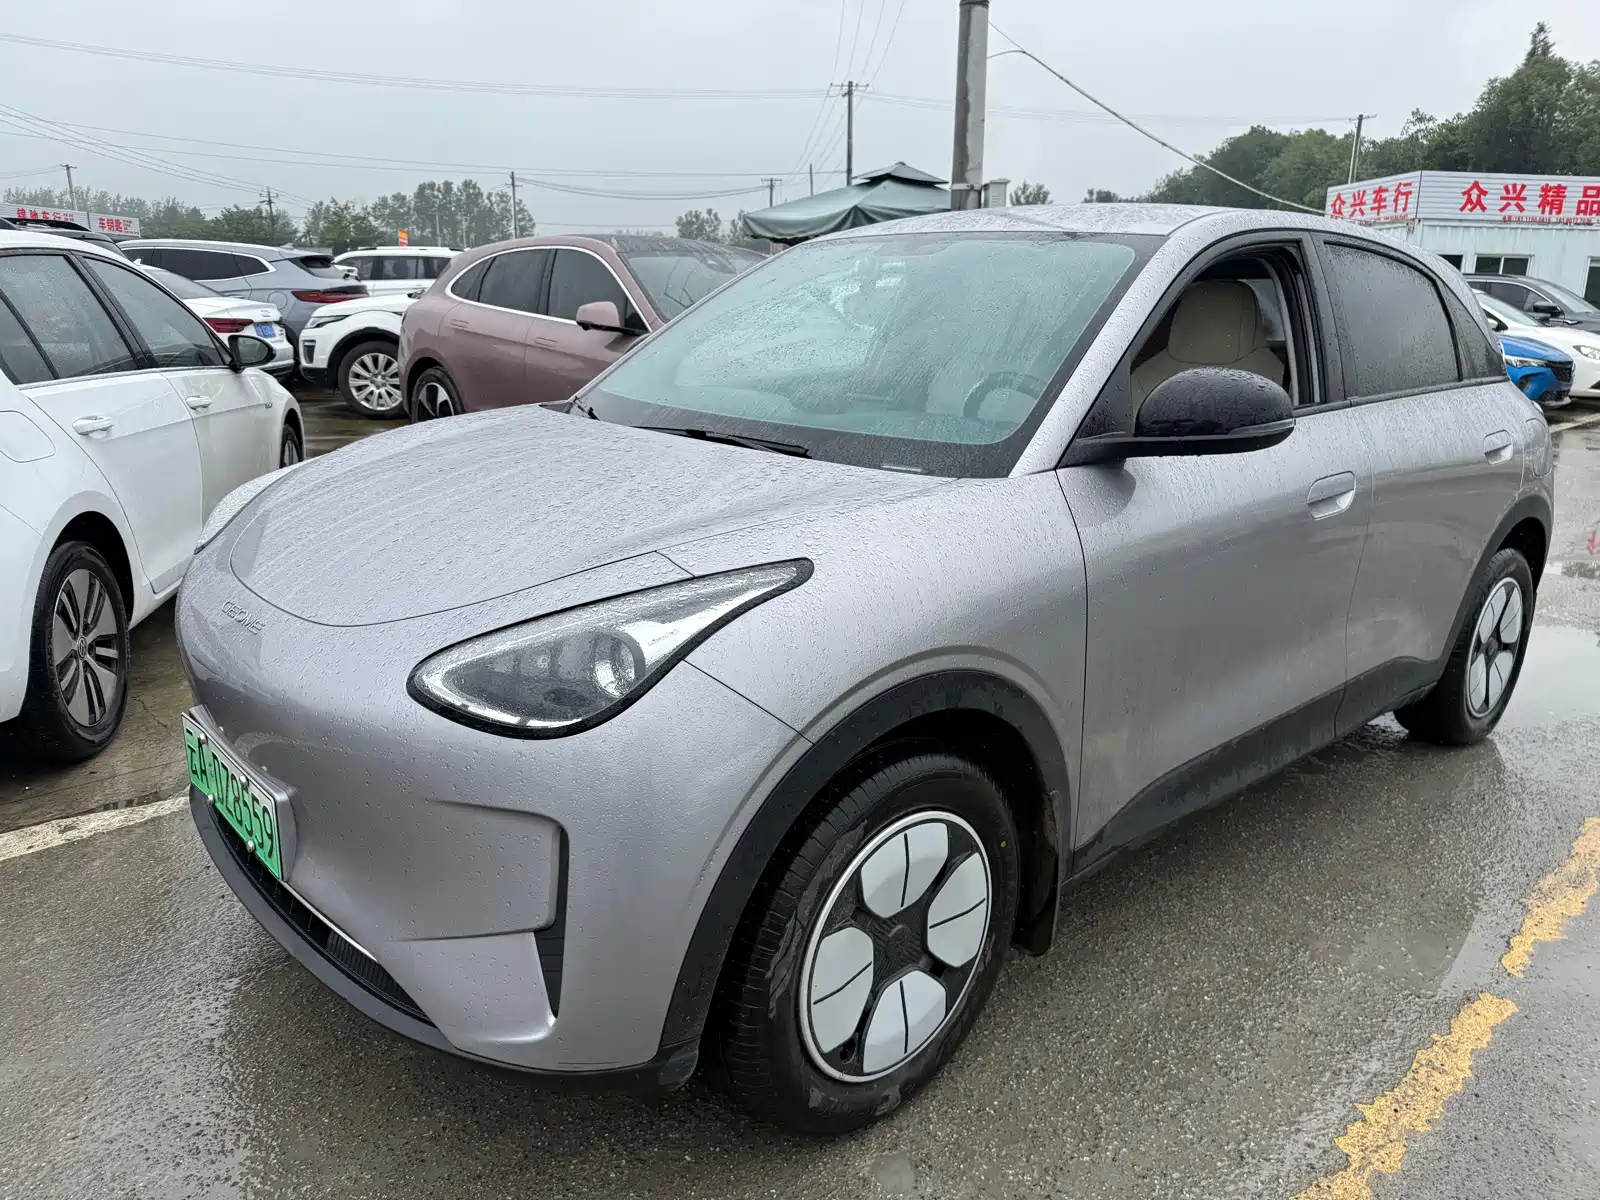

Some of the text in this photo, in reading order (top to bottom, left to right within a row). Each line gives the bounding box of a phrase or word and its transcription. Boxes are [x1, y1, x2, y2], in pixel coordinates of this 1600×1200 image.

[1330, 182, 1413, 218] 众兴车行
[1459, 180, 1600, 216] 众兴精品
